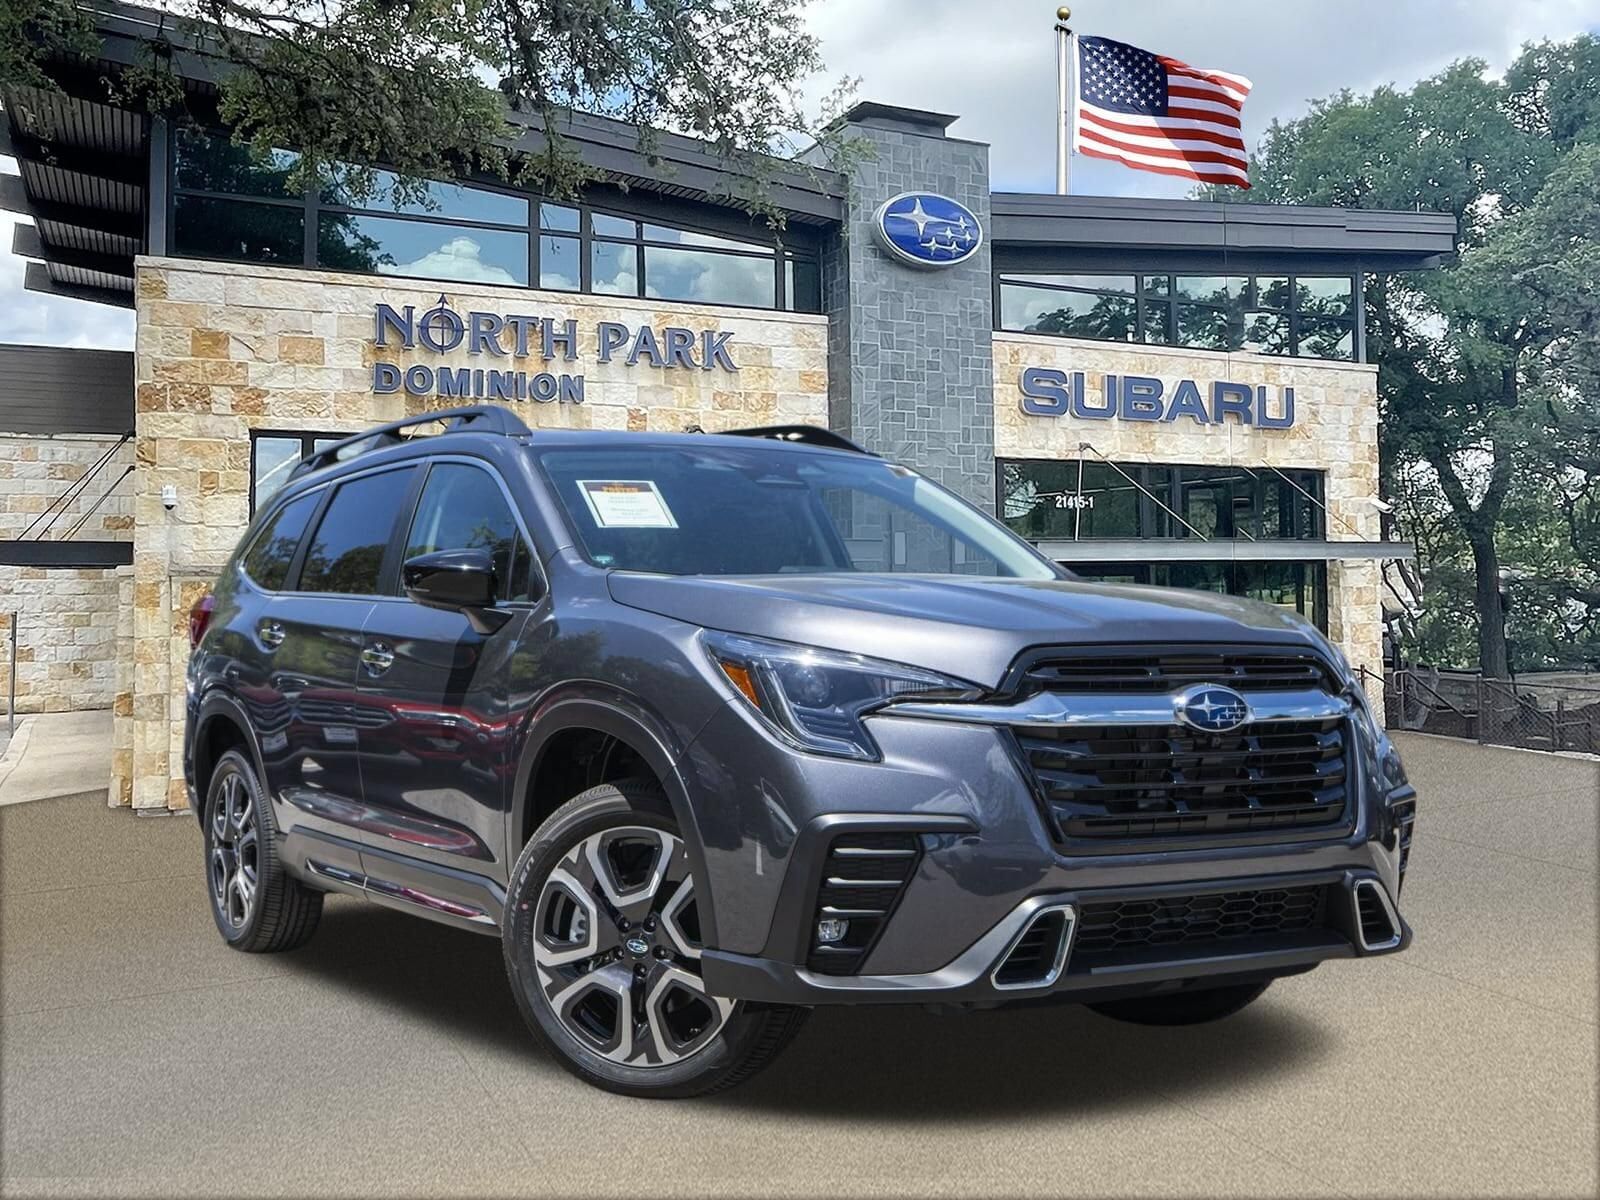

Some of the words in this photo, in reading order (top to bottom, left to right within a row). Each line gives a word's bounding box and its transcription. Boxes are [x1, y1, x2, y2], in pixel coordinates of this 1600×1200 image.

[375, 300, 578, 361] NORTH
[599, 320, 740, 373] PARK
[373, 362, 584, 404] DOMINION
[1019, 367, 1295, 429] SUBARU
